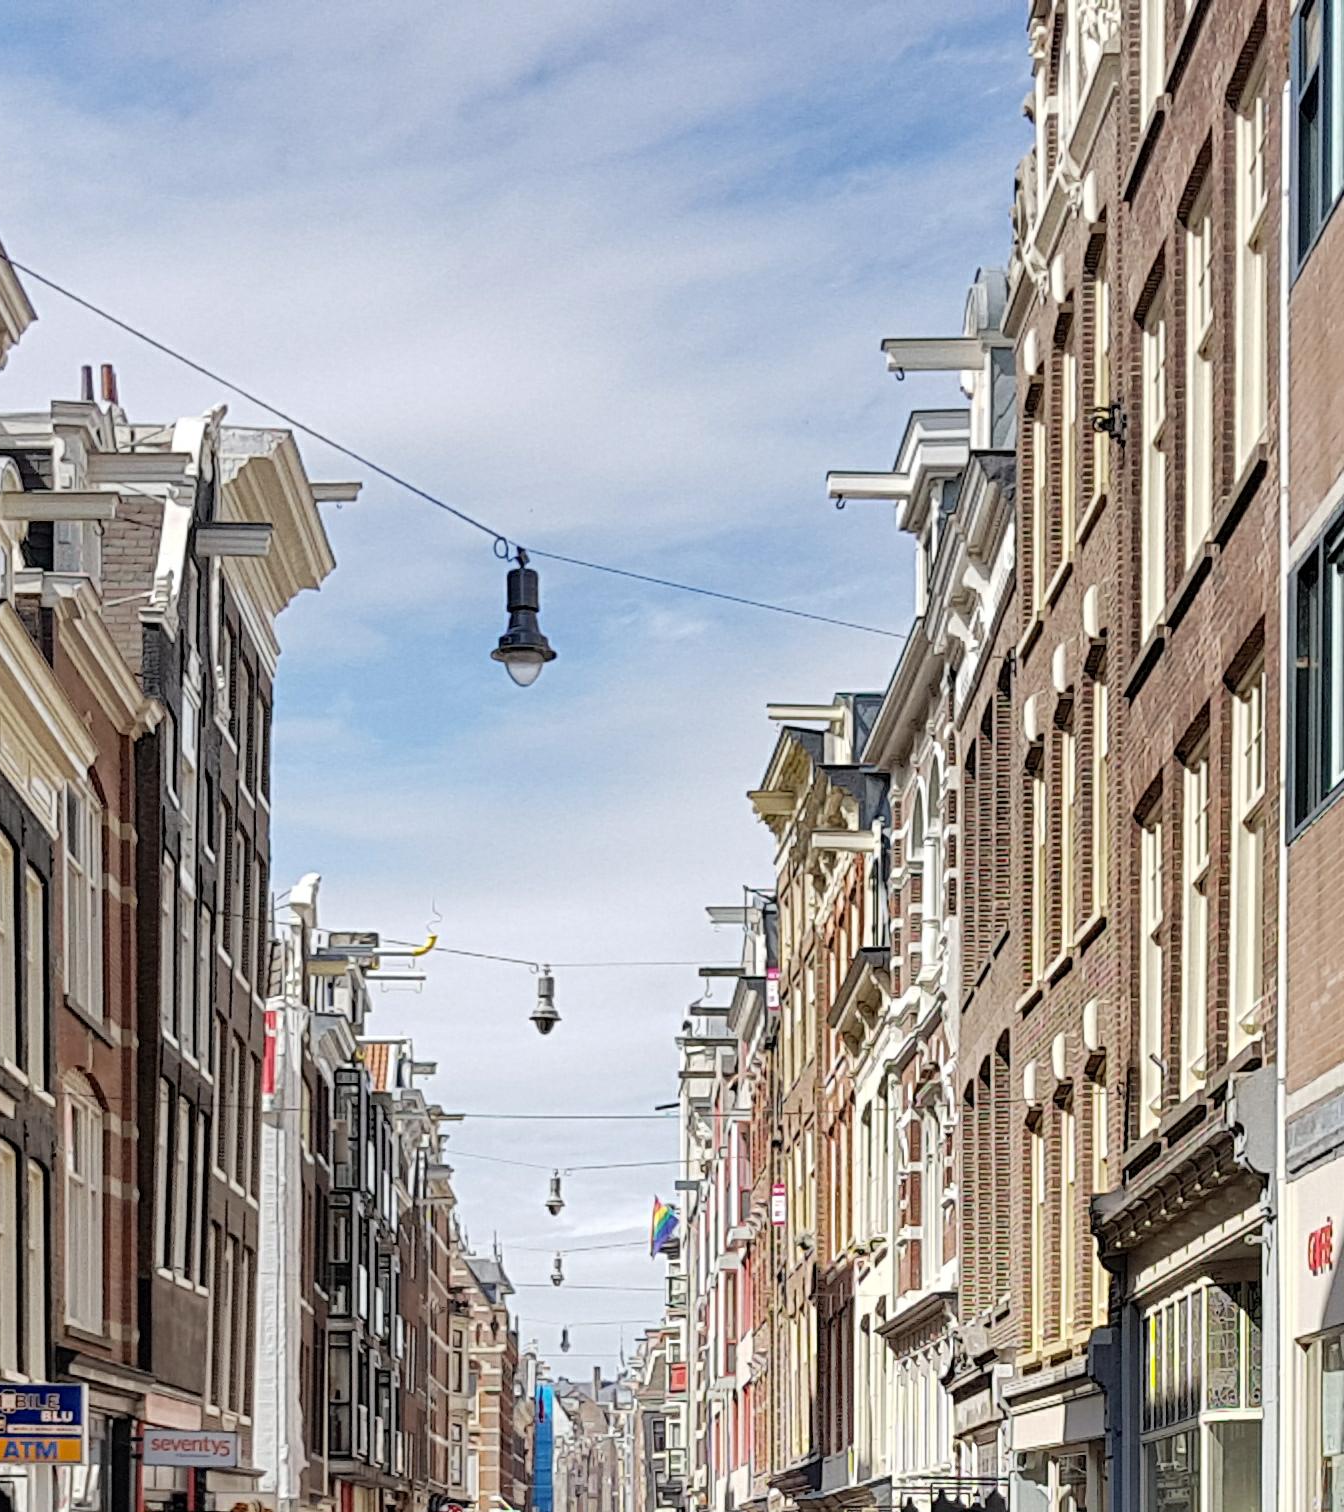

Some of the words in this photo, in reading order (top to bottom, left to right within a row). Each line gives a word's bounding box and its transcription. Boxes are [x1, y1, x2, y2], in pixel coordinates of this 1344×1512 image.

[40, 1410, 74, 1423] BLU
[3, 1440, 59, 1460] ATM
[150, 1435, 231, 1457] seventy5
